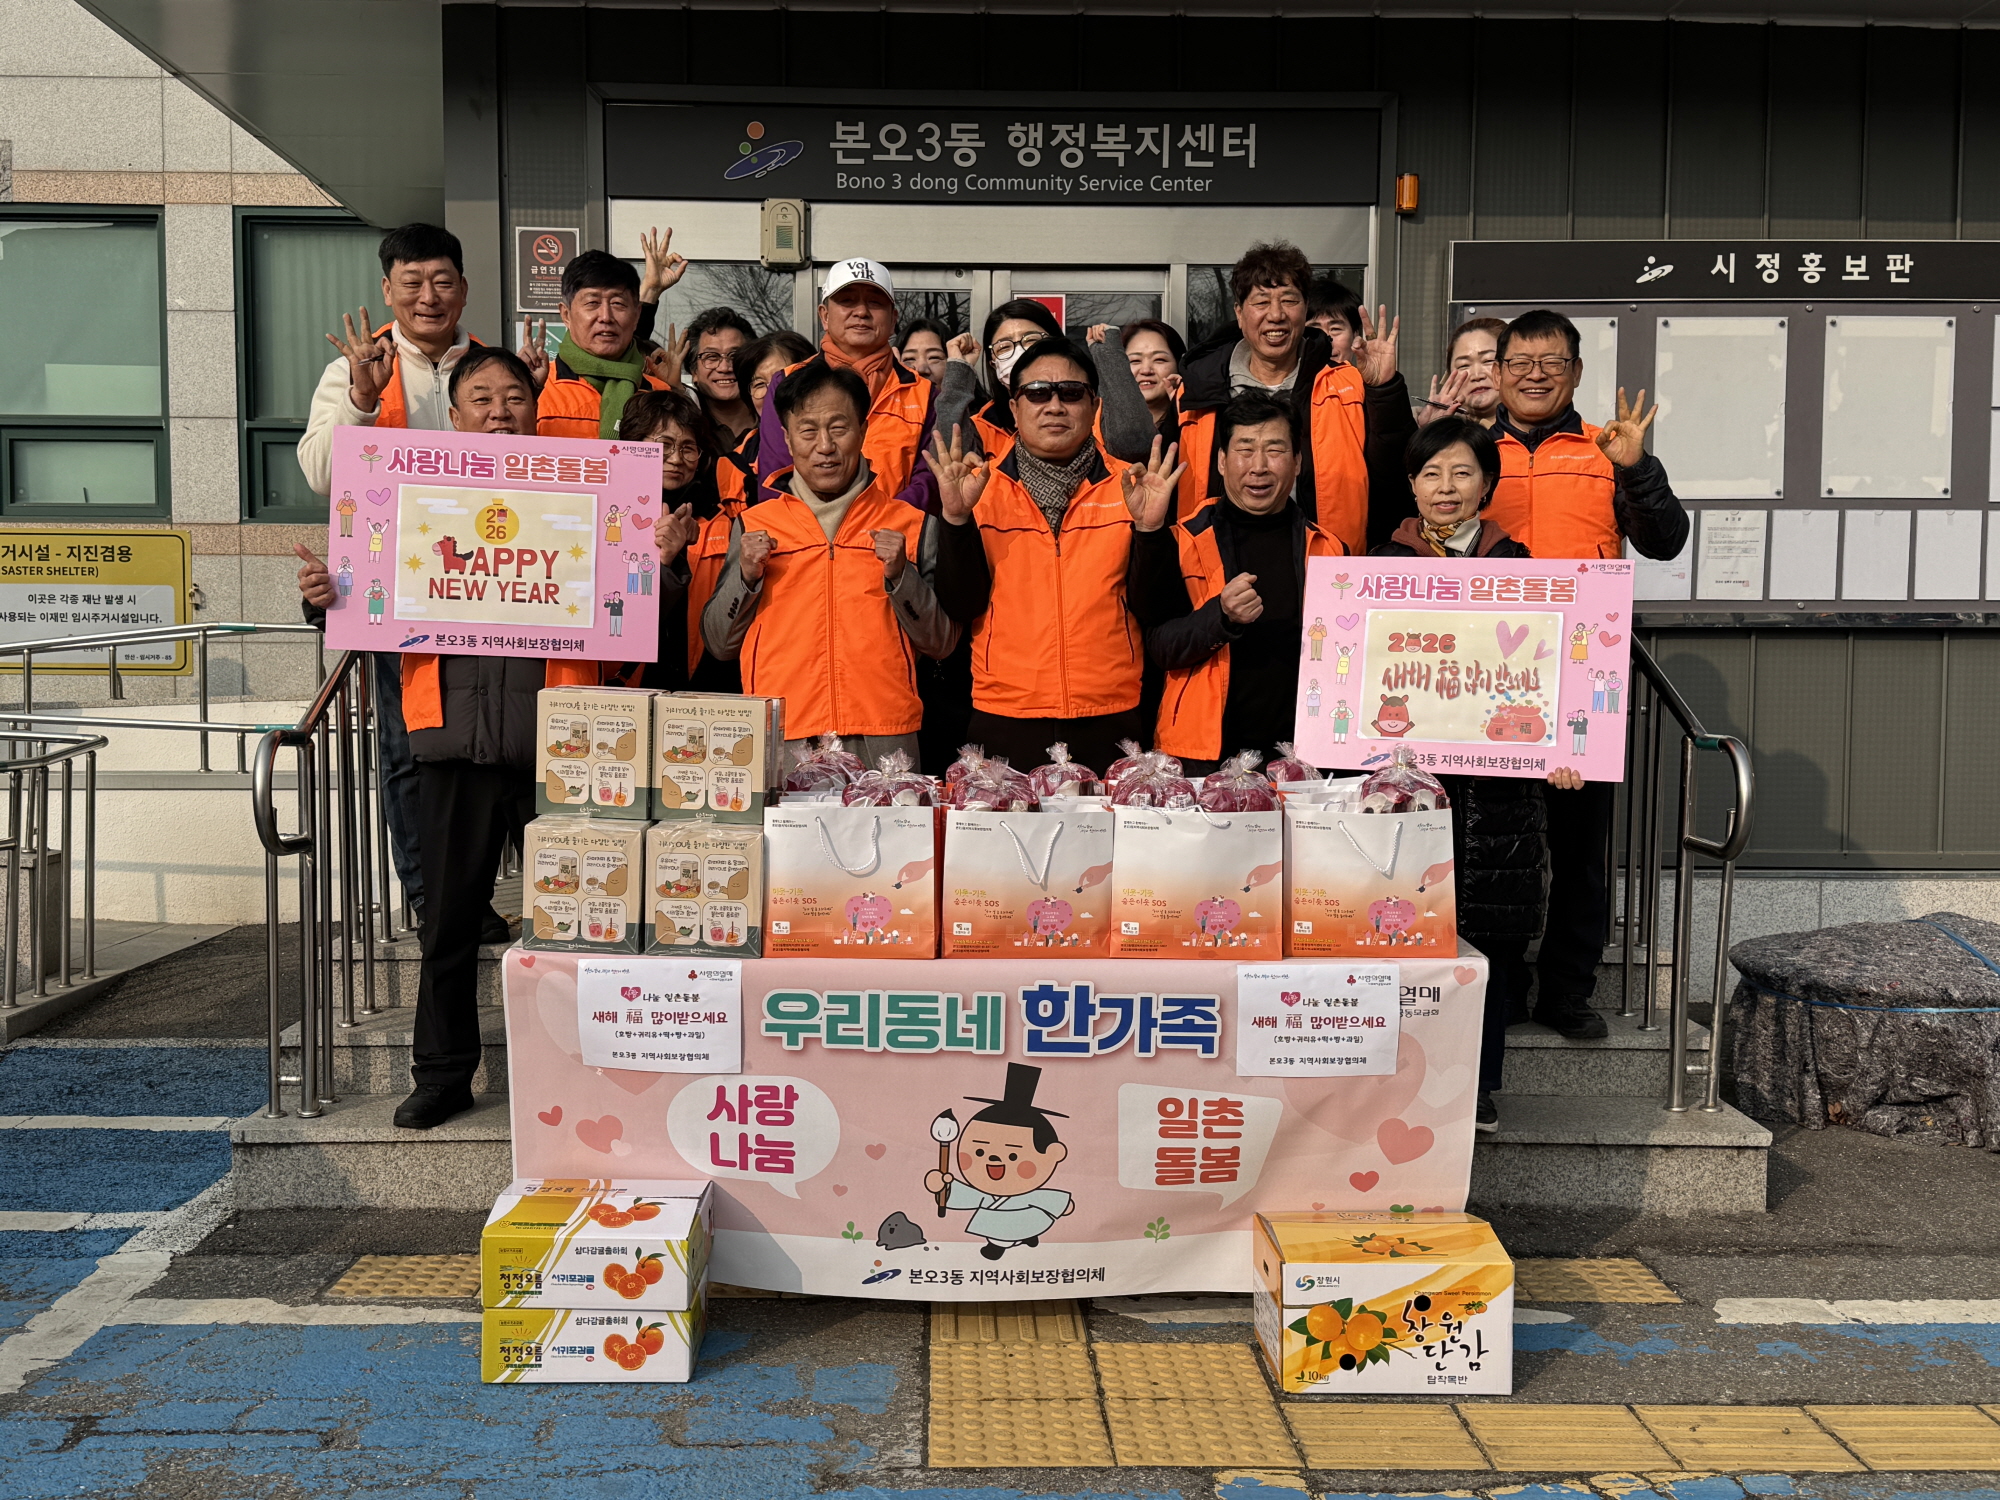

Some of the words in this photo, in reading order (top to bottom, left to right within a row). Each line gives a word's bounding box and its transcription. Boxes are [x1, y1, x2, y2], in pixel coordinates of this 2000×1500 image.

[829, 121, 986, 167] 본오3동
[1007, 122, 1257, 169] 행정복지센터
[836, 172, 886, 190] Bono
[891, 173, 903, 190] 3
[909, 172, 958, 195] dong
[965, 173, 1074, 195] Community
[1079, 174, 1144, 192] Service
[1150, 174, 1213, 192] Center
[847, 262, 869, 270] Vol
[387, 448, 496, 478] 사랑나눔
[503, 454, 609, 485] 일촌돌봄
[485, 525, 507, 540] 26
[66, 544, 133, 563] 지진겸용
[46, 566, 99, 578] SHELTER)
[428, 577, 488, 601] NEW
[497, 581, 560, 605] YEAR
[1356, 575, 1463, 602] 사랑나눔
[1469, 576, 1577, 604] 일촌돌봄
[27, 594, 57, 605] 이곳은
[59, 594, 79, 605] 각종
[82, 594, 101, 605] 재난
[104, 594, 124, 605] 발생
[127, 595, 136, 605] 시
[40, 612, 68, 623] 이재민
[72, 612, 162, 624] 임시주거시설입니다.
[434, 633, 478, 648] 본오3동
[482, 635, 585, 652] 지역사회보장협의체
[1382, 661, 1432, 692] 새해
[1435, 659, 1462, 700] 福
[1440, 754, 1546, 771] 지역사회보장협의체
[802, 897, 817, 905] SOS
[592, 1011, 618, 1024] 새해
[626, 1008, 643, 1024] 福
[651, 1011, 728, 1025] 많이받으세요
[763, 991, 1002, 1050] 우리동네
[1021, 983, 1222, 1057] 한가족
[1251, 1016, 1278, 1029] 새해
[1286, 1013, 1302, 1029] 福
[1310, 1016, 1387, 1030] 많이받으세요
[612, 1051, 637, 1060] 본오3동
[641, 1052, 710, 1061] 지역사회보장협의체
[1269, 1057, 1295, 1065] 본오3동
[1299, 1057, 1367, 1065] 지역사회보장협의체
[706, 1083, 800, 1128] 사랑
[1156, 1096, 1245, 1140] 일촌
[708, 1131, 797, 1175] 나눔
[1154, 1144, 1242, 1187] 돌봄
[499, 1273, 543, 1289] 청정오름
[908, 1269, 965, 1285] 본오3동
[969, 1267, 1106, 1286] 지역사회보장협의체
[1402, 1299, 1463, 1344] 창원
[499, 1345, 543, 1363] 청정오름
[1422, 1329, 1490, 1372] 단감
